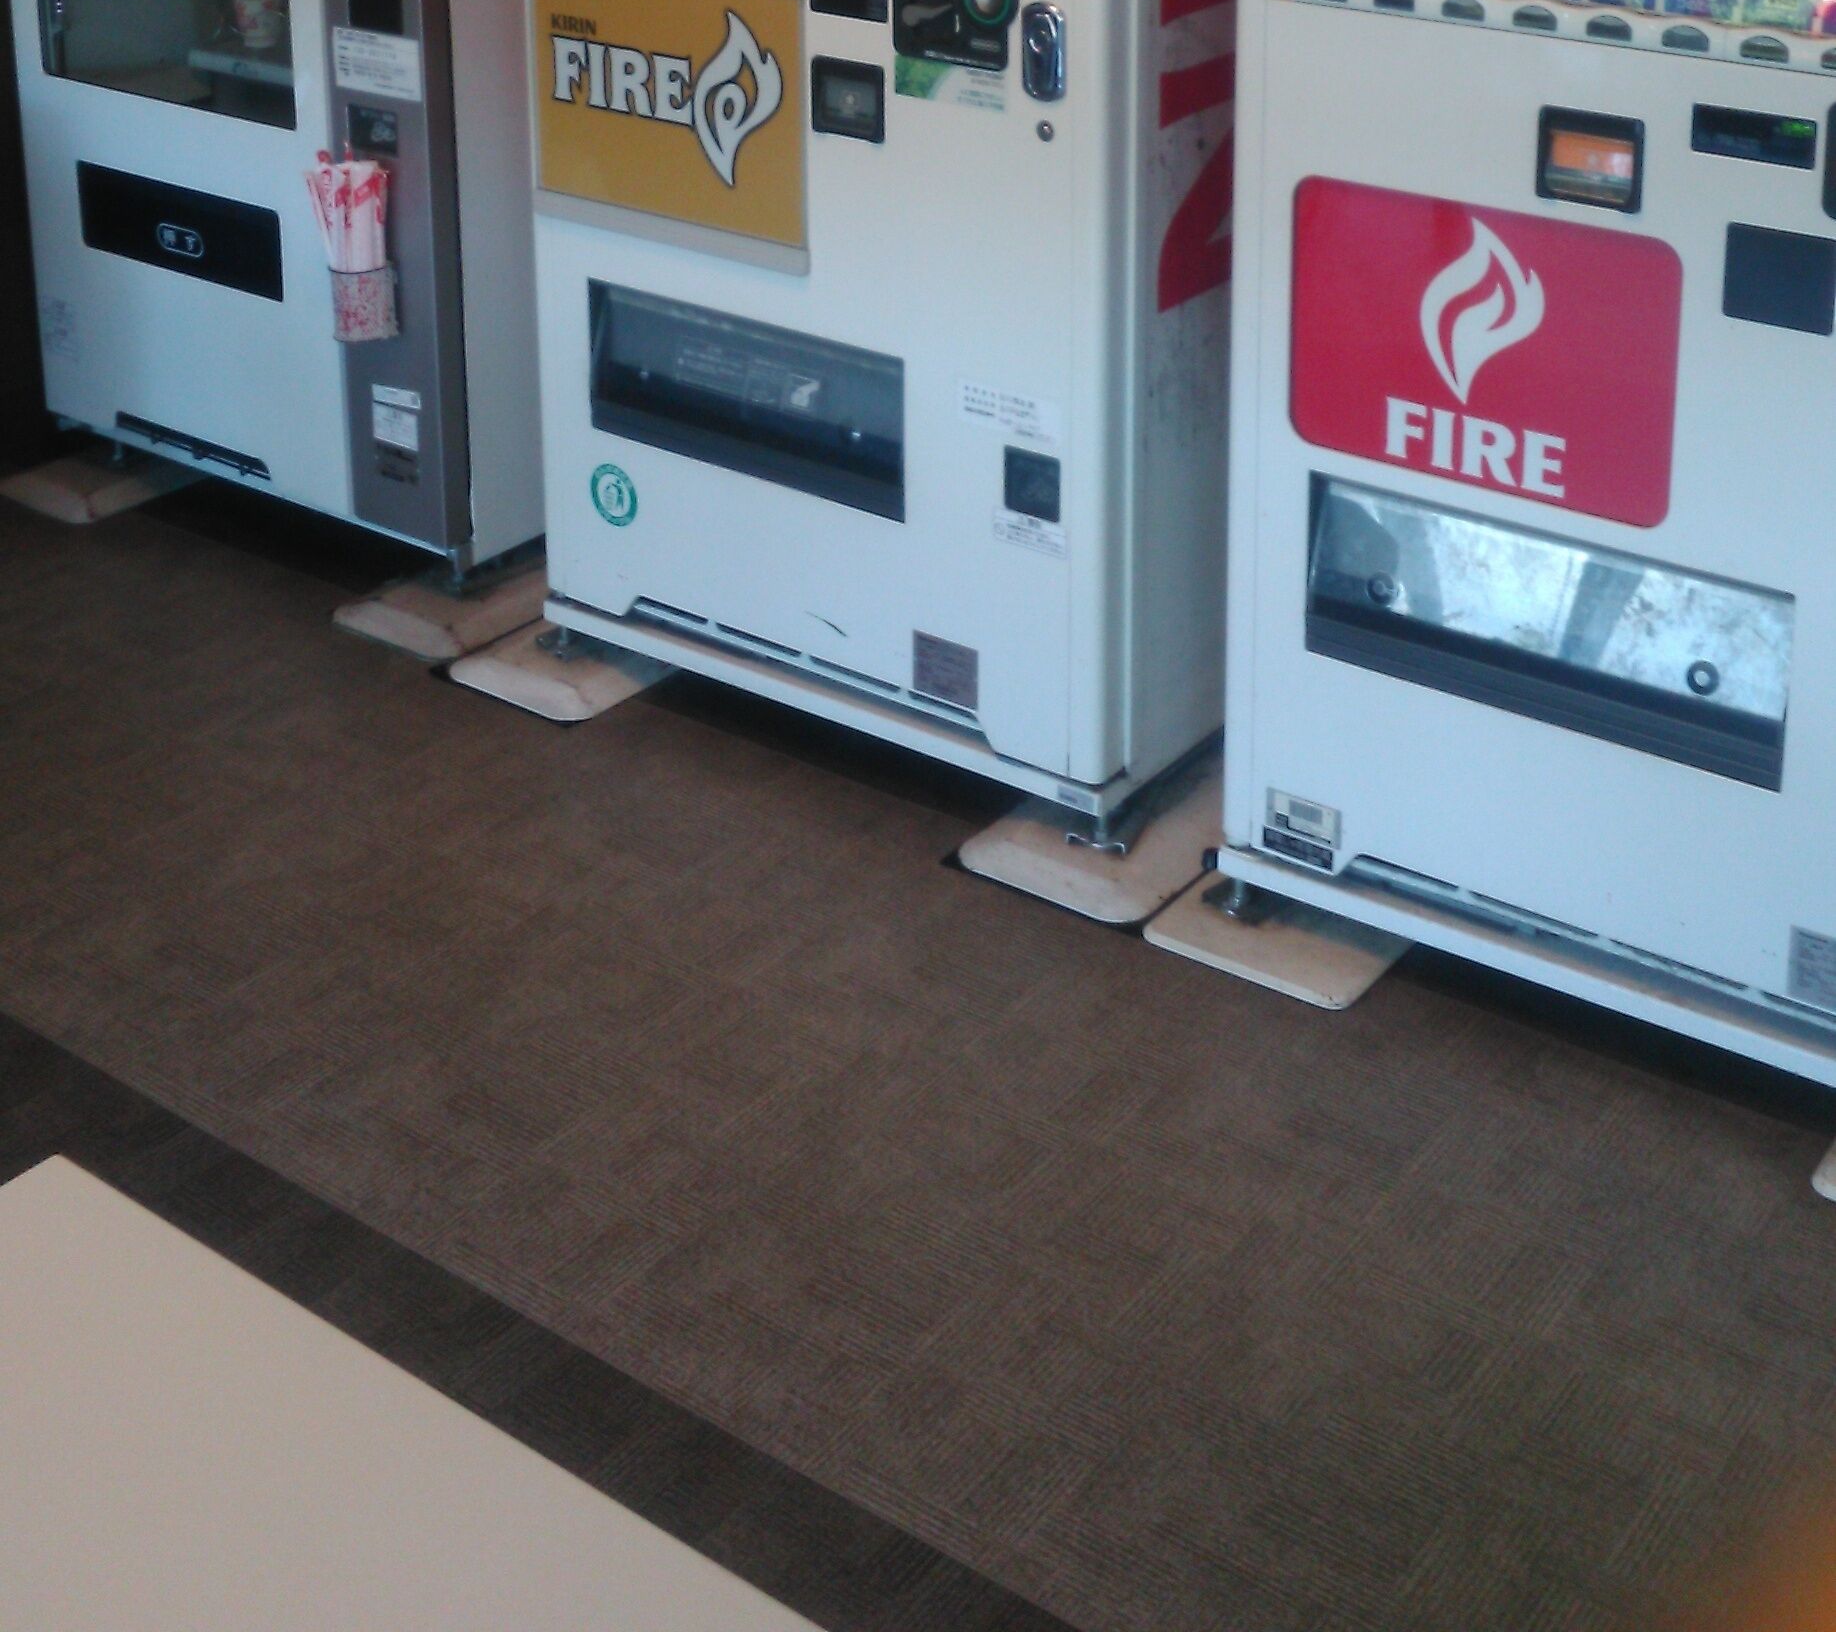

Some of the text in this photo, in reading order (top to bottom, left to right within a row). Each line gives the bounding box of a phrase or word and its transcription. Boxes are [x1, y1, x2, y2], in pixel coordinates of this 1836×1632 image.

[551, 13, 597, 36] KIRIN
[551, 24, 696, 130] FIRE
[1385, 395, 1566, 499] FIRE
